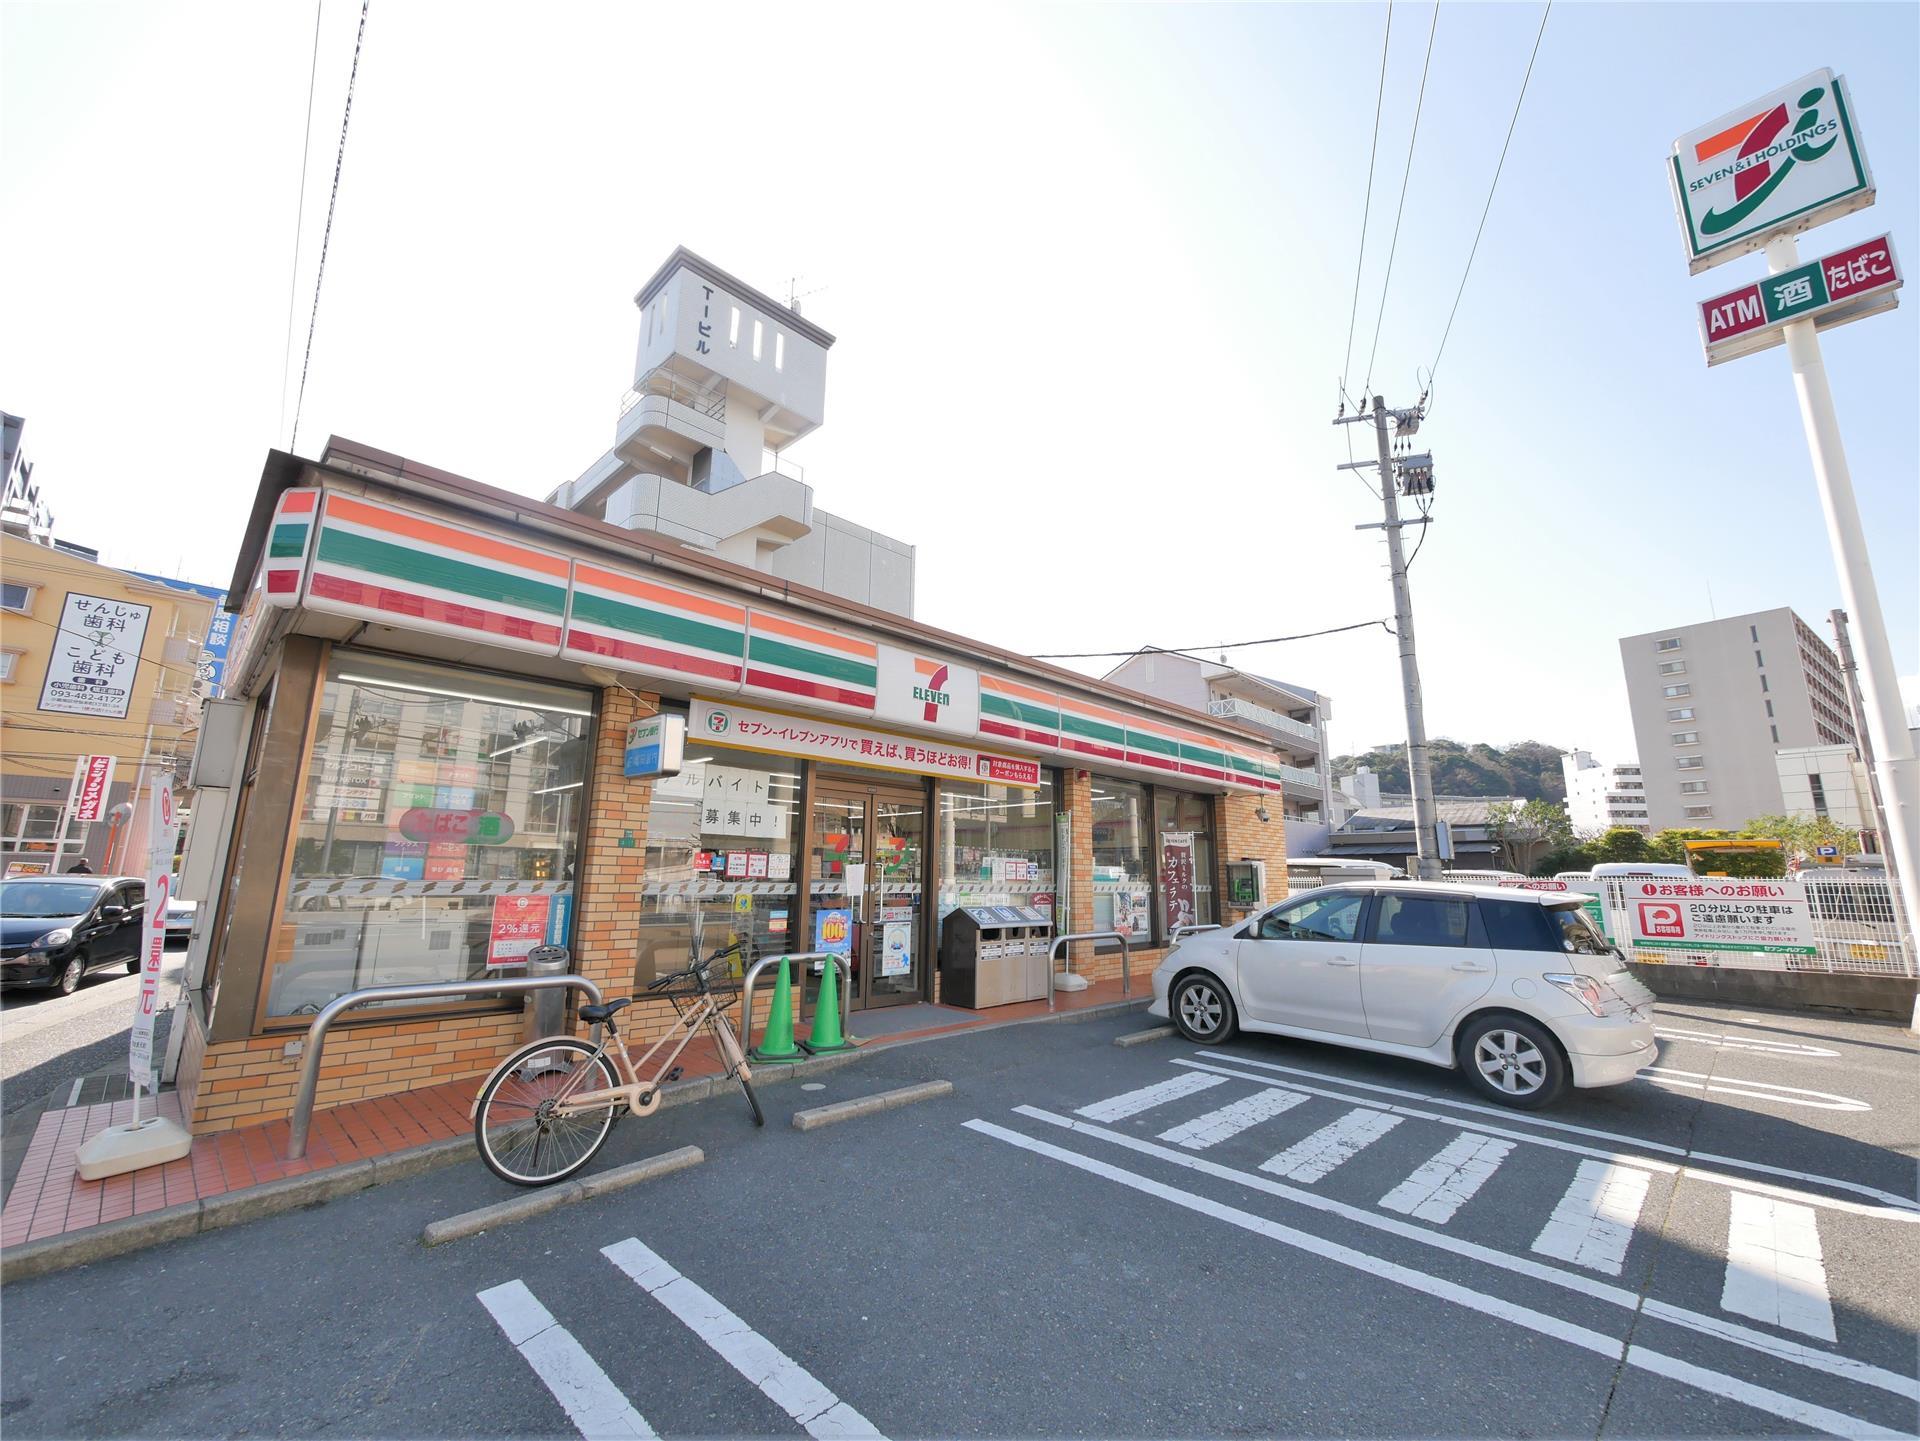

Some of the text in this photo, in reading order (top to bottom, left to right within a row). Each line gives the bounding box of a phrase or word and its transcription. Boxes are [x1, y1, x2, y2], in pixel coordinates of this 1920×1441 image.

[1755, 118, 1837, 163] HOLDINGS
[1827, 250, 1892, 292] たばこ
[1773, 276, 1813, 311] 酒
[1710, 294, 1761, 334] ATM
[75, 599, 141, 620] せんじゅ
[83, 614, 126, 632] 歯科
[67, 646, 125, 665] こども
[72, 660, 115, 678] 歯科
[50, 689, 123, 704] 093-482-4177
[78, 757, 108, 819] ビジョンメガネ
[413, 812, 468, 834] たばこ
[1167, 856, 1180, 912] カフェラテ
[1659, 884, 1785, 898] お客様へのお願い
[1689, 903, 1794, 915] 20分以上の駐車は
[1691, 913, 1775, 925] ご遠慮願います
[498, 923, 540, 934] 2%還元
